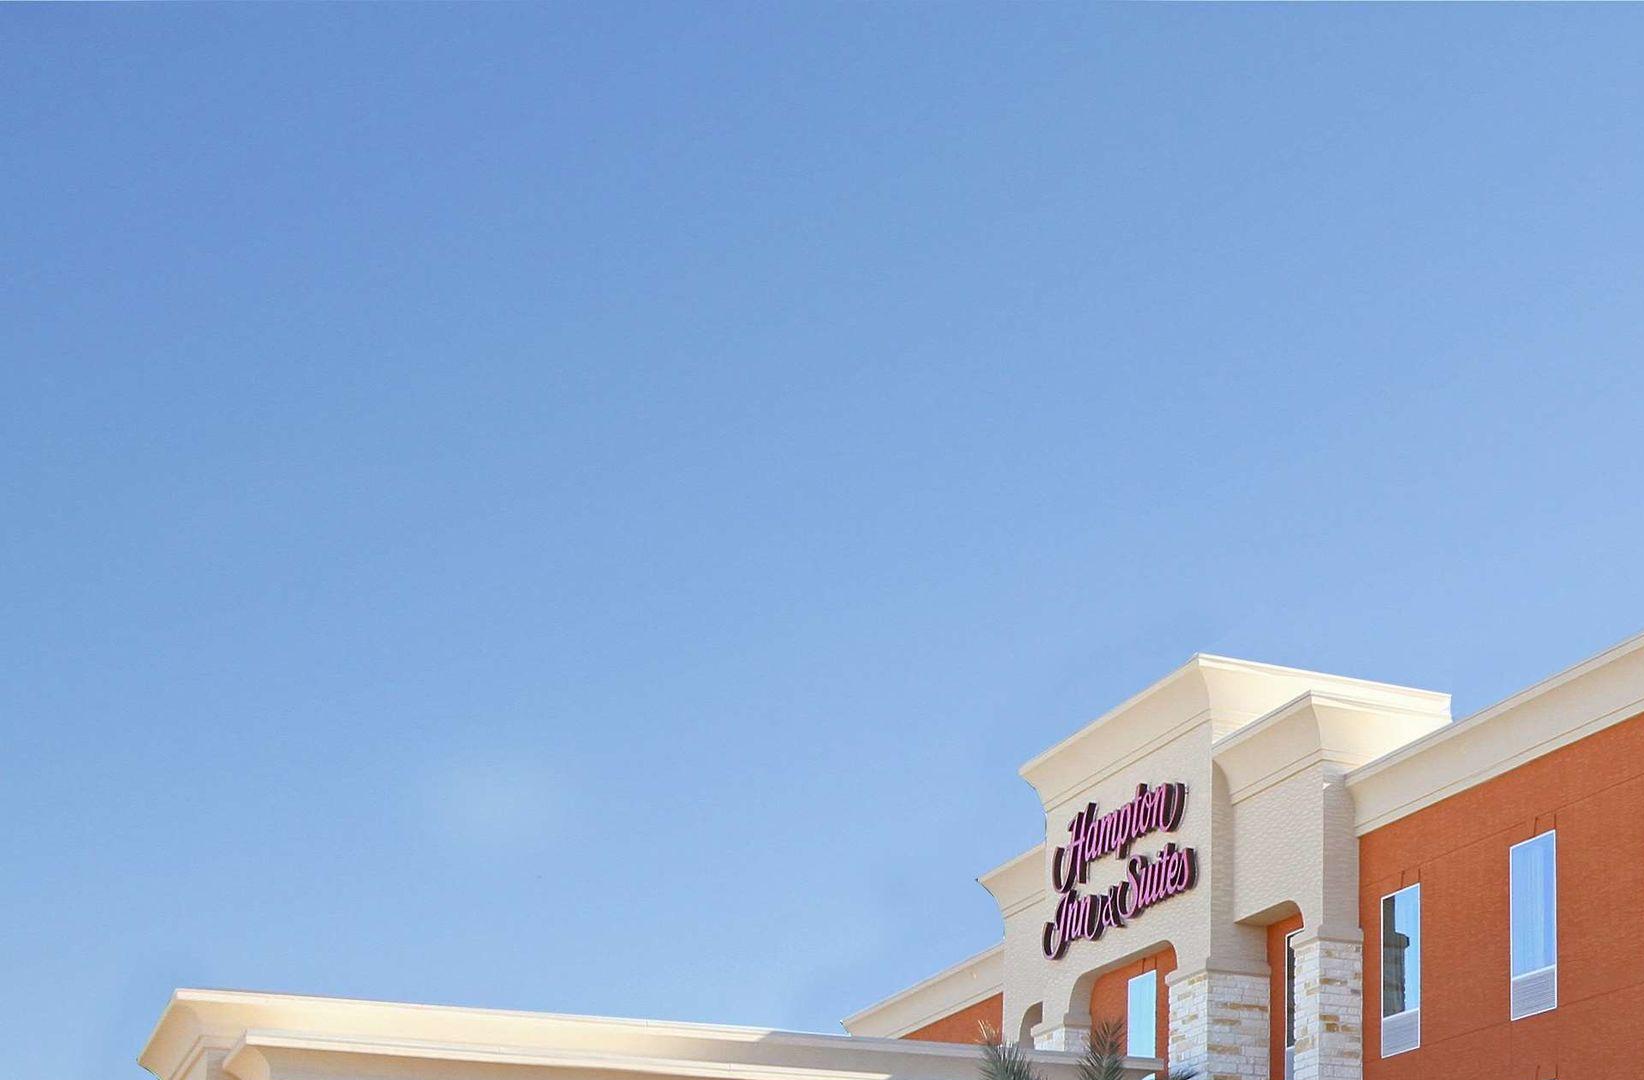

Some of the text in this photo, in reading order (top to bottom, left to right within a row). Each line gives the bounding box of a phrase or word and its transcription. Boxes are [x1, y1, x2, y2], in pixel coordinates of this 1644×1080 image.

[1052, 783, 1187, 893] Hampton
[1042, 843, 1197, 960] Inn & Suites
